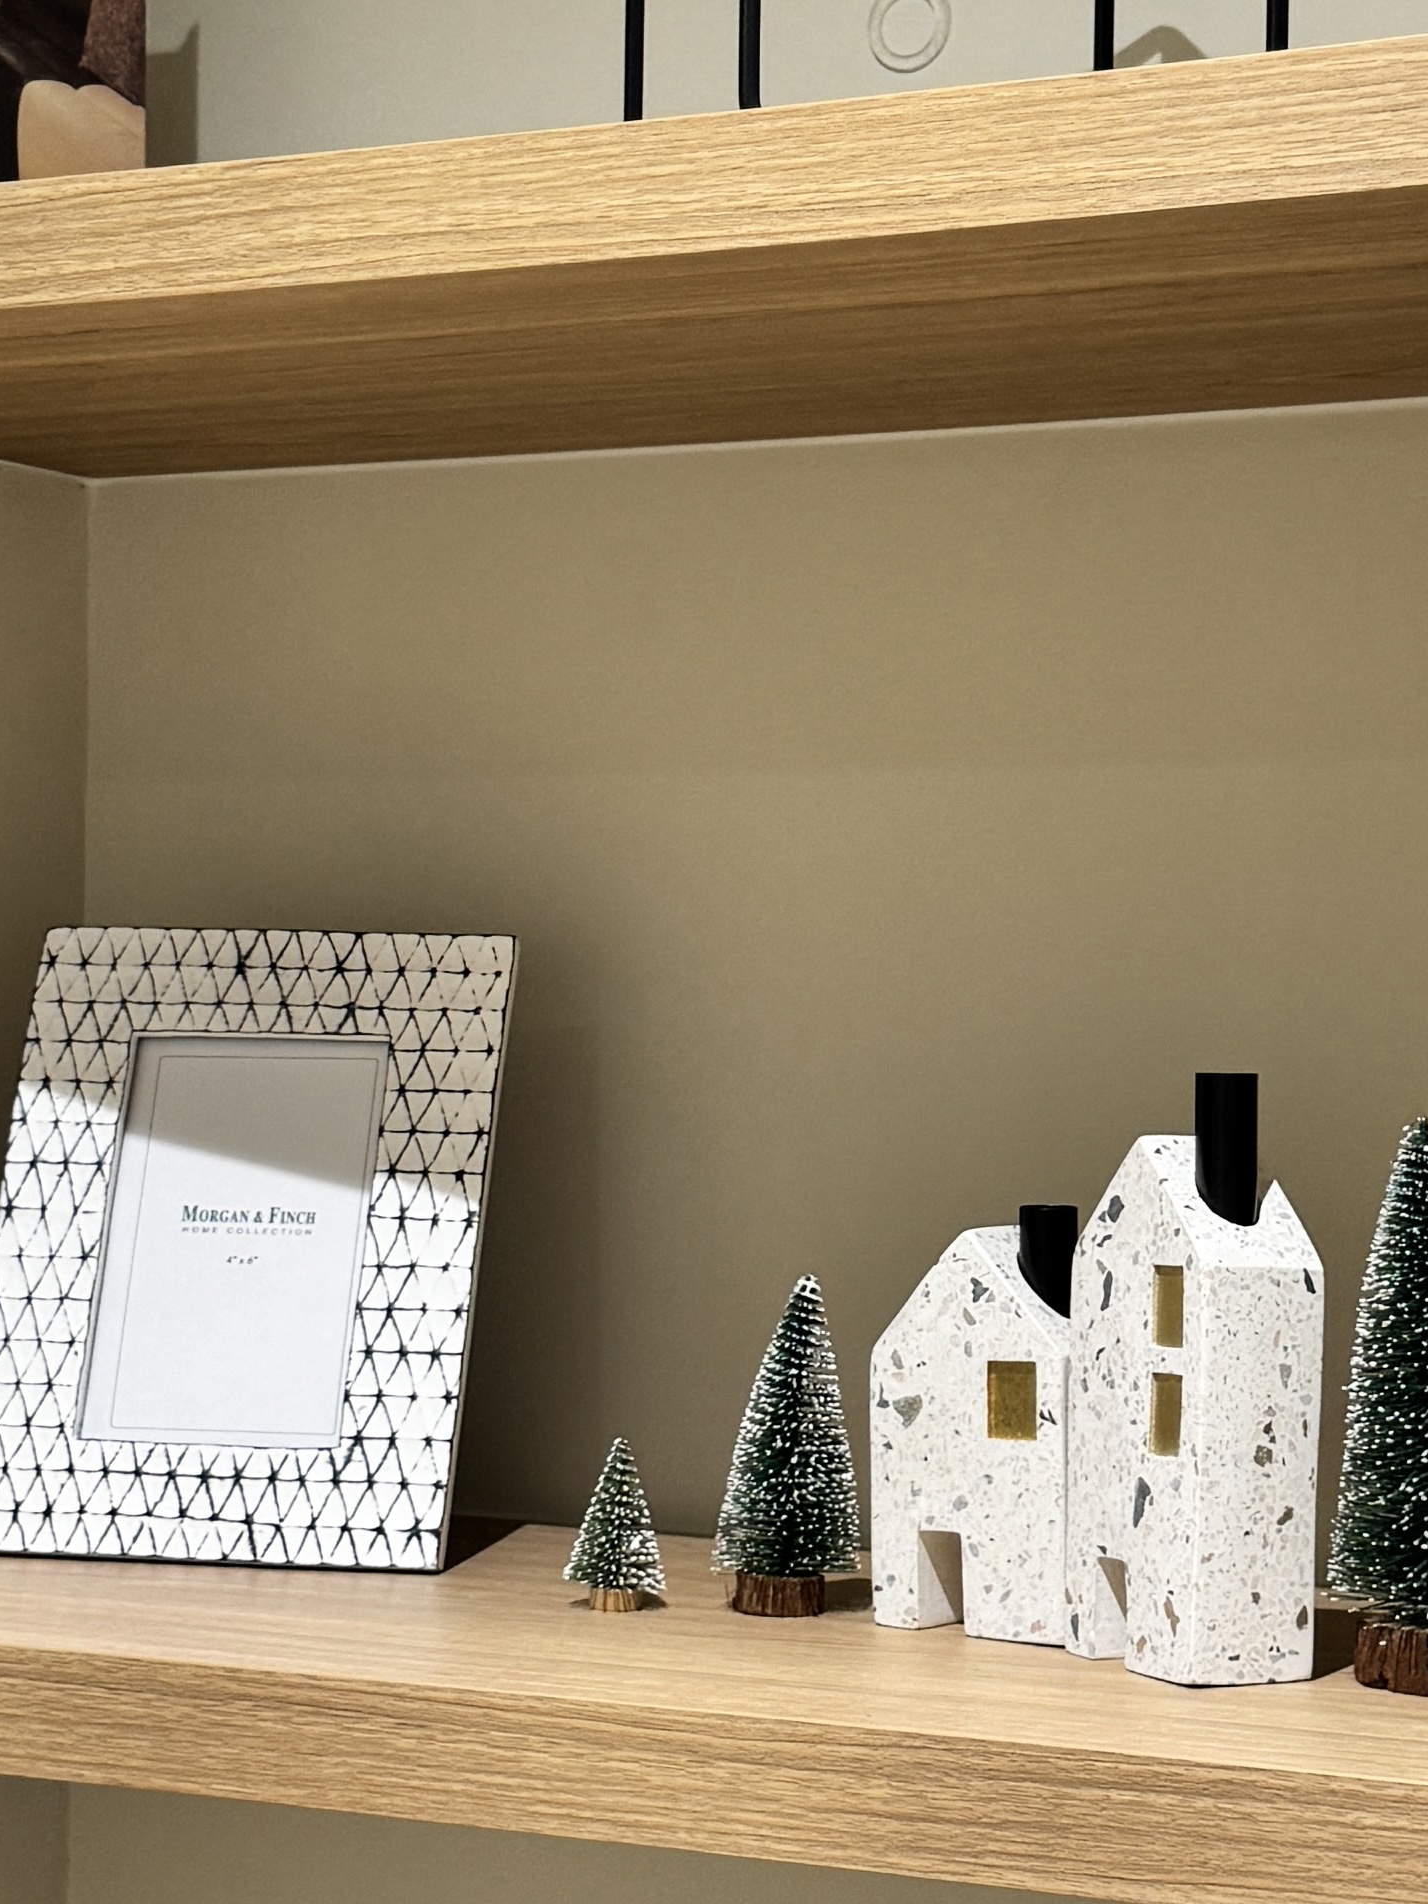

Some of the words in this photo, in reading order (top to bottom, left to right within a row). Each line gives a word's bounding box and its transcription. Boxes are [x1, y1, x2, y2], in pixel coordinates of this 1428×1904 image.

[181, 1205, 250, 1223] MORGAN
[253, 1211, 263, 1223] &
[268, 1206, 316, 1225] FINCH
[182, 1226, 218, 1234] HOME
[227, 1227, 313, 1236] COLLECTION
